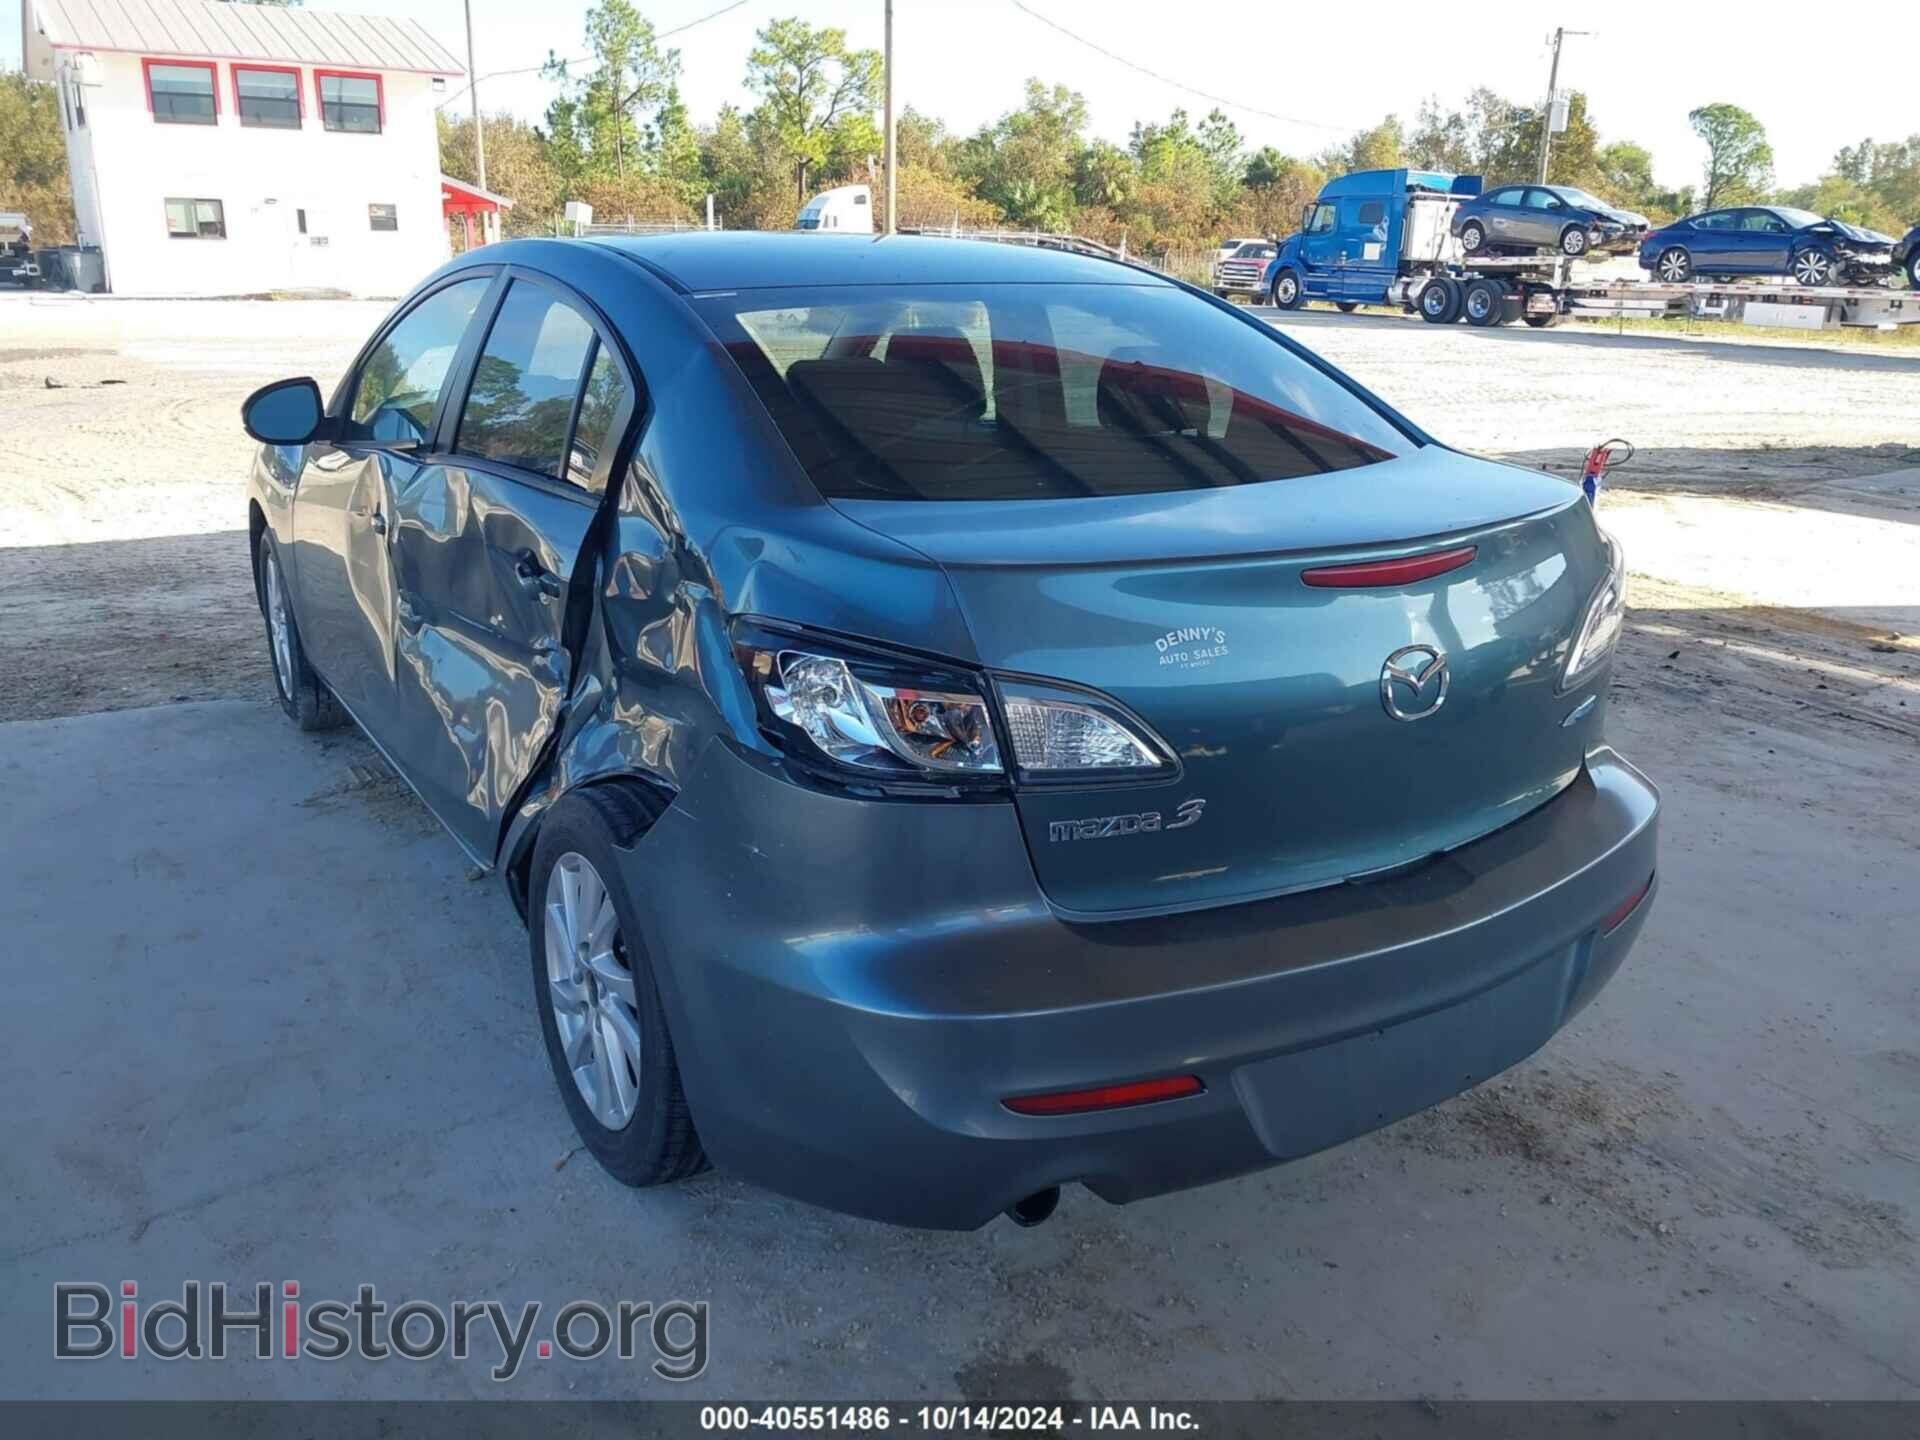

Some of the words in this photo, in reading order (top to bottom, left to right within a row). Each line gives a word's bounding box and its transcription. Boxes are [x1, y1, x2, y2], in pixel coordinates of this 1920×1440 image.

[1155, 627, 1225, 652] DENNY'S
[1160, 652, 1188, 665] AUTO
[1193, 645, 1229, 660] SALES
[1166, 799, 1206, 829] 3
